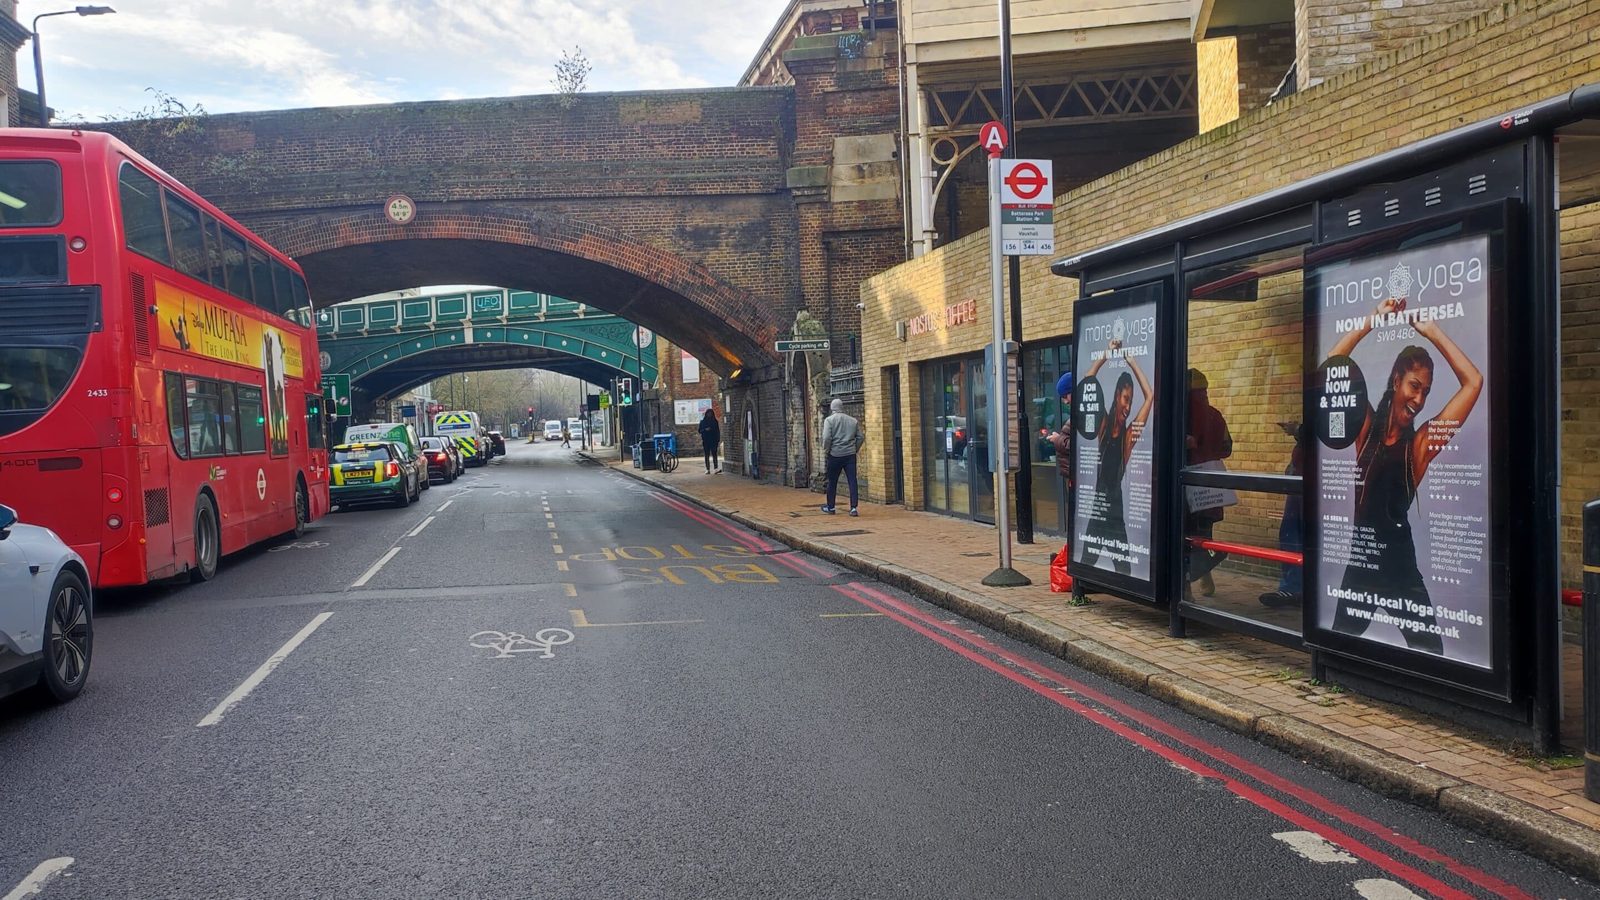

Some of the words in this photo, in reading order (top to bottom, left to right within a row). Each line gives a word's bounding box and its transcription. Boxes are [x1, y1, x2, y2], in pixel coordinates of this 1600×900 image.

[986, 127, 1004, 149] A
[1326, 276, 1382, 307] more
[1418, 258, 1481, 302] yoga
[476, 296, 498, 306] UFO
[941, 299, 975, 328] OFFEE
[1336, 316, 1366, 333] NOW
[1371, 313, 1385, 329] IN
[1388, 302, 1464, 326] BATTERSEA
[204, 304, 248, 346] MUFASA
[1085, 324, 1111, 342] more
[1127, 317, 1154, 343] yoga
[1377, 330, 1395, 342] SW8
[1397, 328, 1415, 340] 4BG
[1105, 350, 1112, 359] IN
[1114, 345, 1148, 358] BATTERSEA
[1326, 366, 1348, 381] JOIN
[87, 389, 108, 397] 2433
[1326, 380, 1350, 393] NOW
[1080, 403, 1085, 411] &
[1087, 403, 1099, 411] SAVE
[1320, 396, 1328, 408] &
[1331, 394, 1356, 407] SAVE
[1079, 532, 1100, 544] London's
[1102, 537, 1115, 548] Local
[1116, 540, 1128, 551] Yoga
[1129, 543, 1149, 555] Studios
[1448, 544, 1482, 554] compromising
[569, 544, 755, 561] STOP
[1459, 553, 1481, 561] teaching
[617, 563, 780, 585] BUS
[1327, 585, 1372, 604] London's
[1374, 593, 1402, 609] Local
[1404, 599, 1433, 617] Yoga
[1436, 605, 1483, 626] Studios
[1347, 606, 1460, 639] www.moreyoga.co.uk
